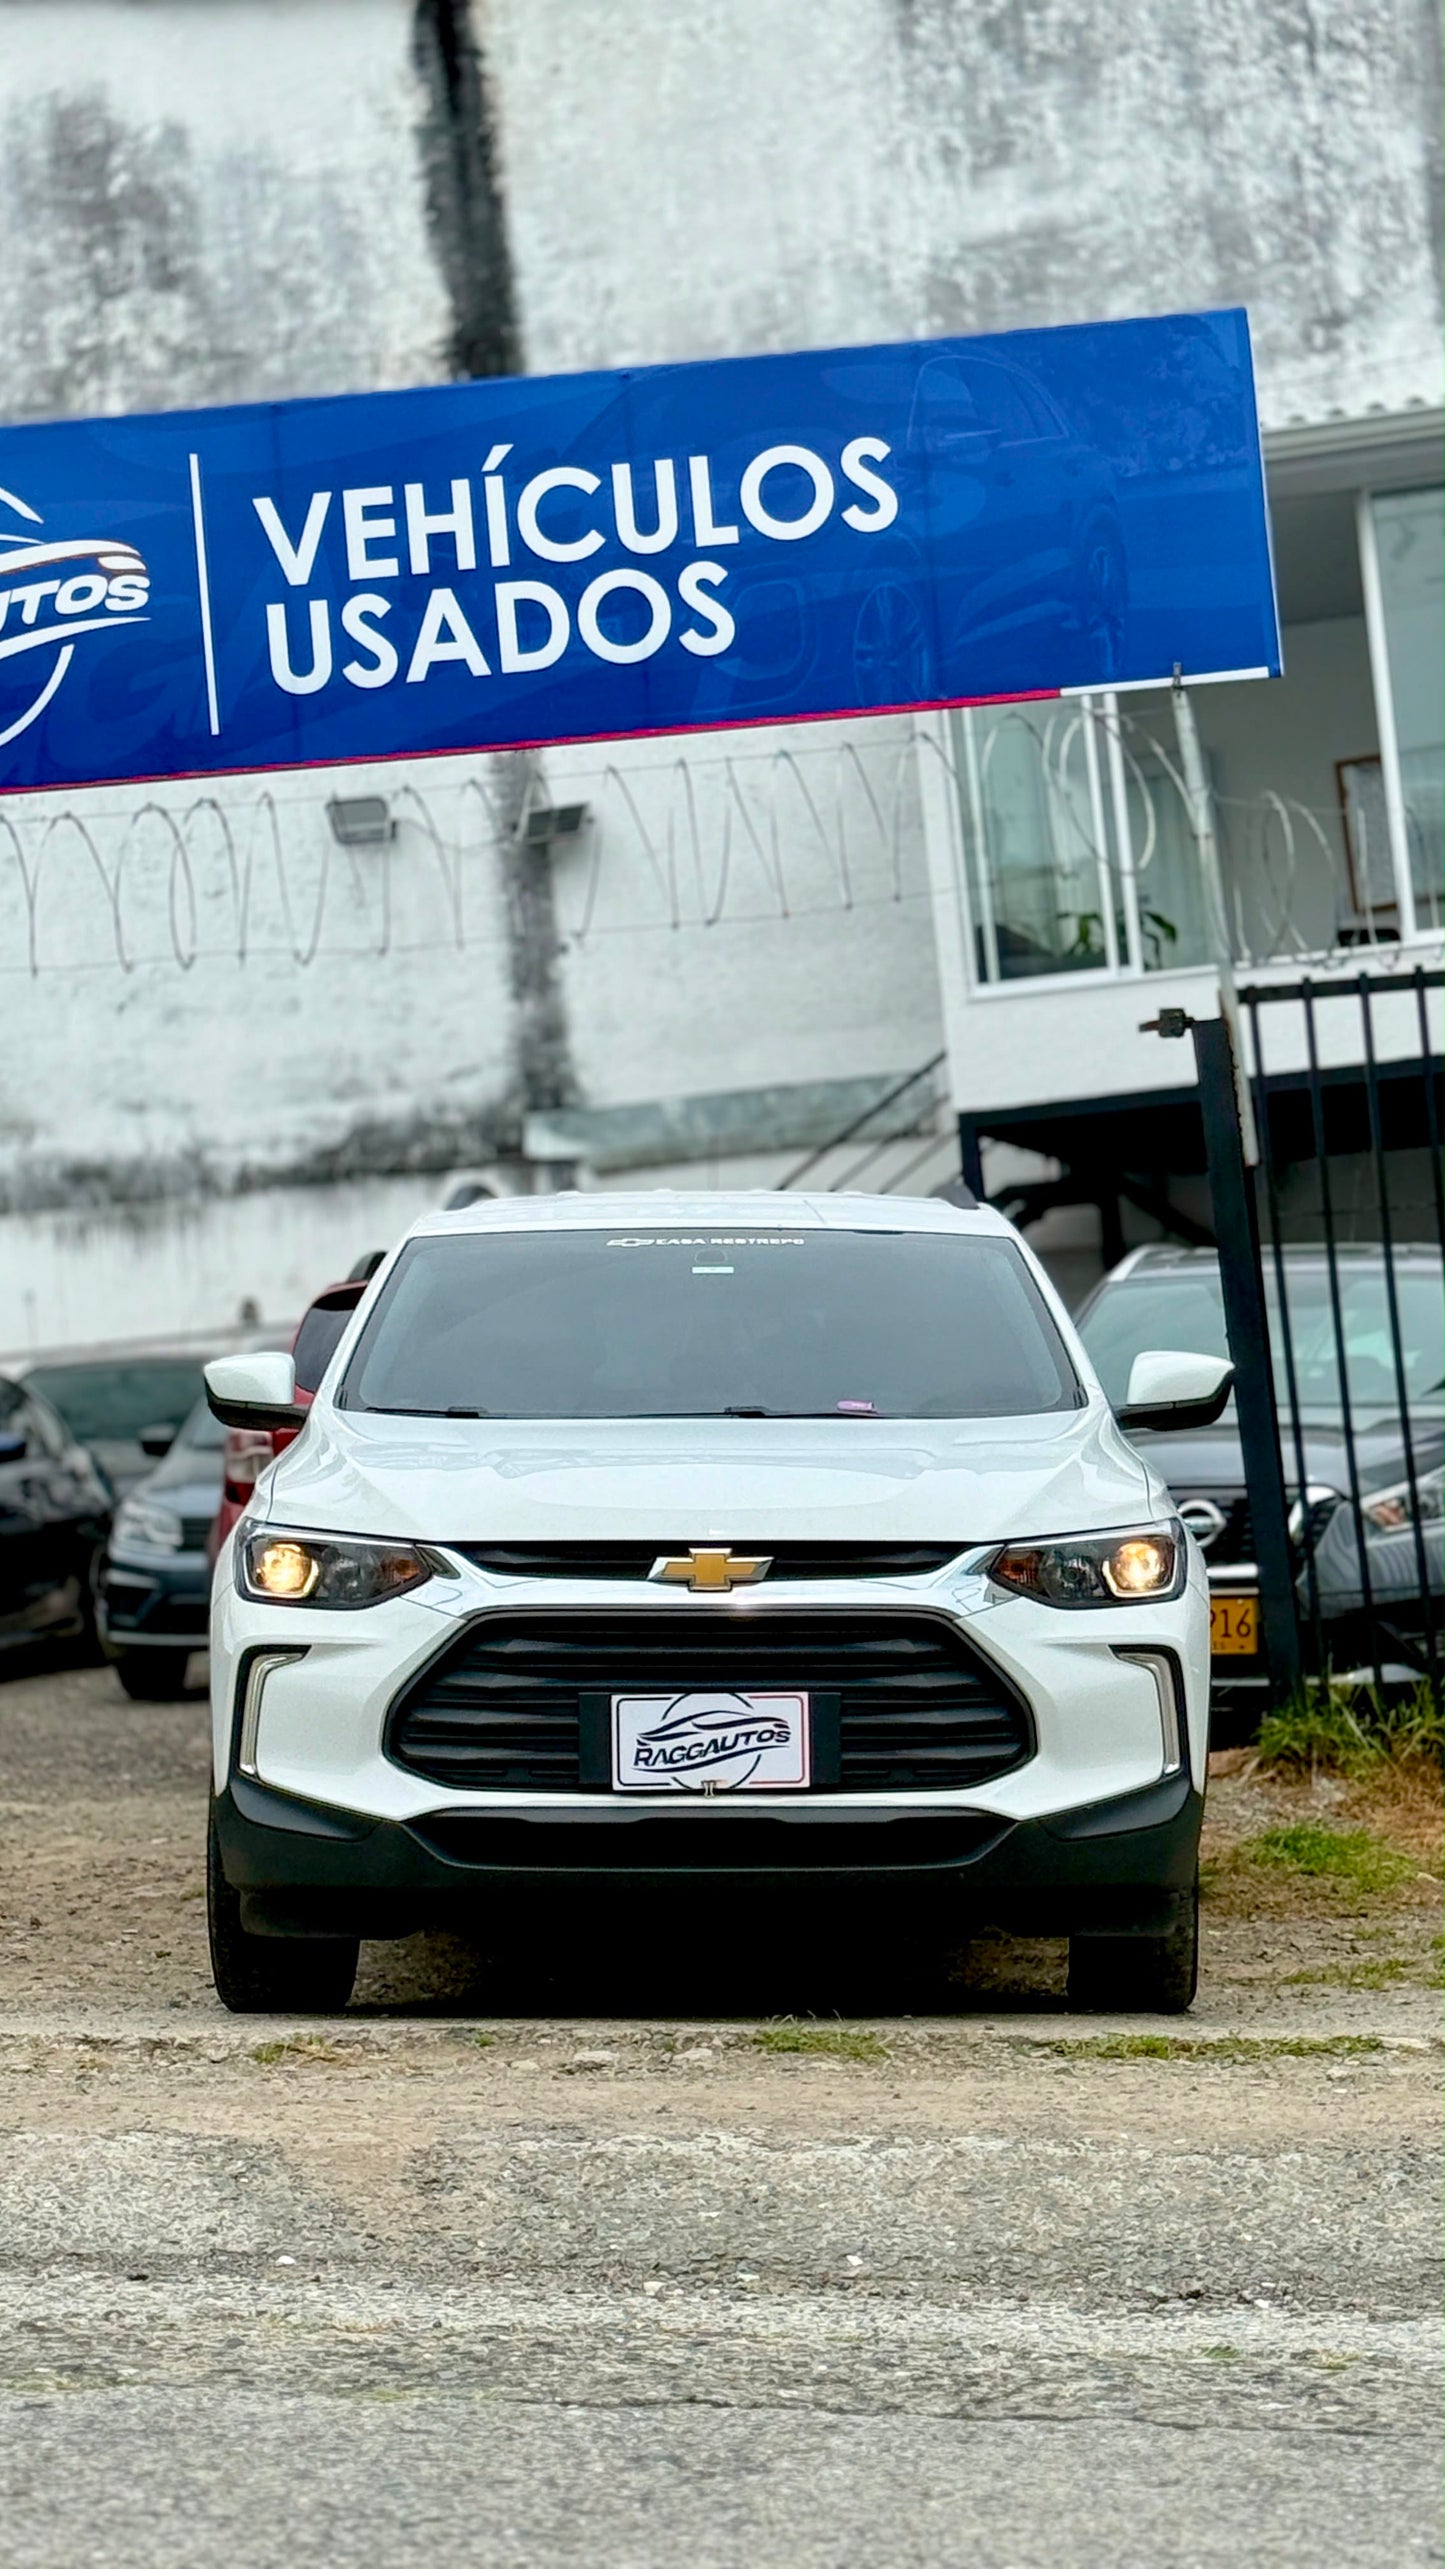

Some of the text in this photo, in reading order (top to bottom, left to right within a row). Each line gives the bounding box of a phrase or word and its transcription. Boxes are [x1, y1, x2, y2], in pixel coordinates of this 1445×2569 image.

[252, 436, 899, 586] VEHÍCULOS
[266, 561, 735, 695] USADOS
[710, 1238, 805, 1246] RESTREPO
[633, 1728, 792, 1767] RAGGAUTOS
